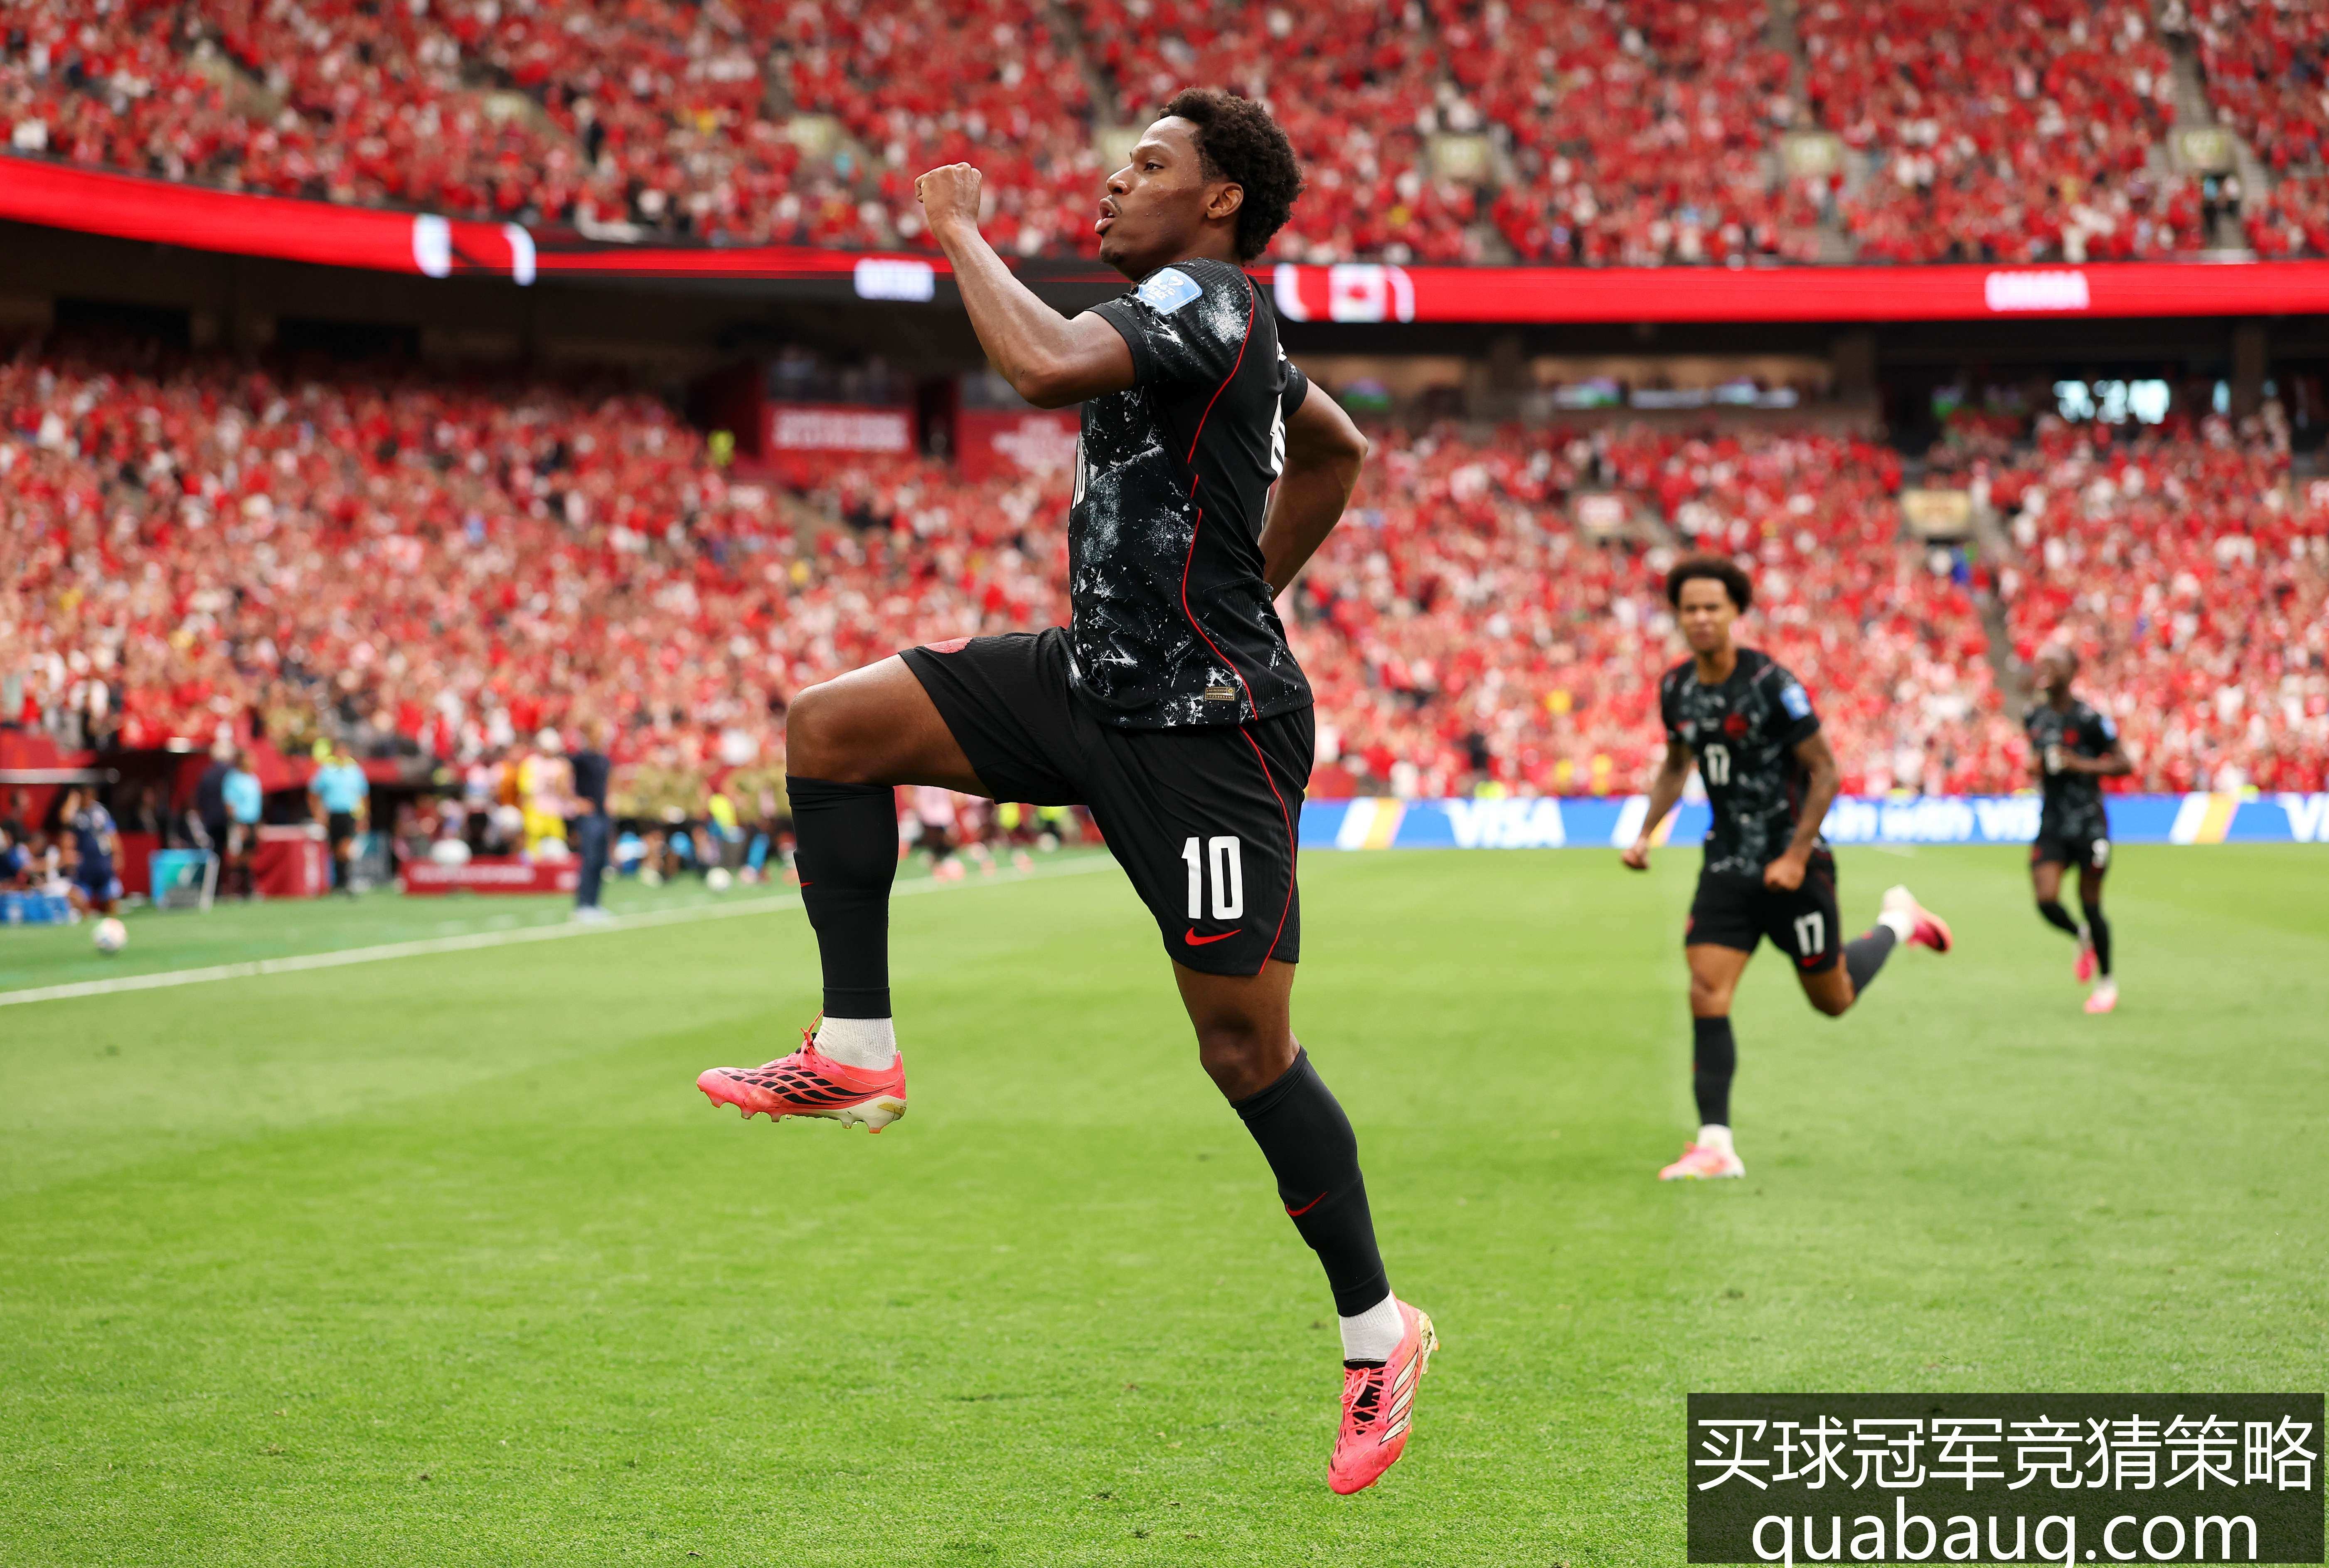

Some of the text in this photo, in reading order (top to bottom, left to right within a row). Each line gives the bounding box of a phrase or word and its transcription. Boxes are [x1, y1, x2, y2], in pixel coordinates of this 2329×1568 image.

[1704, 742, 1731, 786] 17
[1442, 795, 1567, 849] VISA
[1181, 836, 1243, 920] 10
[1793, 910, 1825, 956] 17
